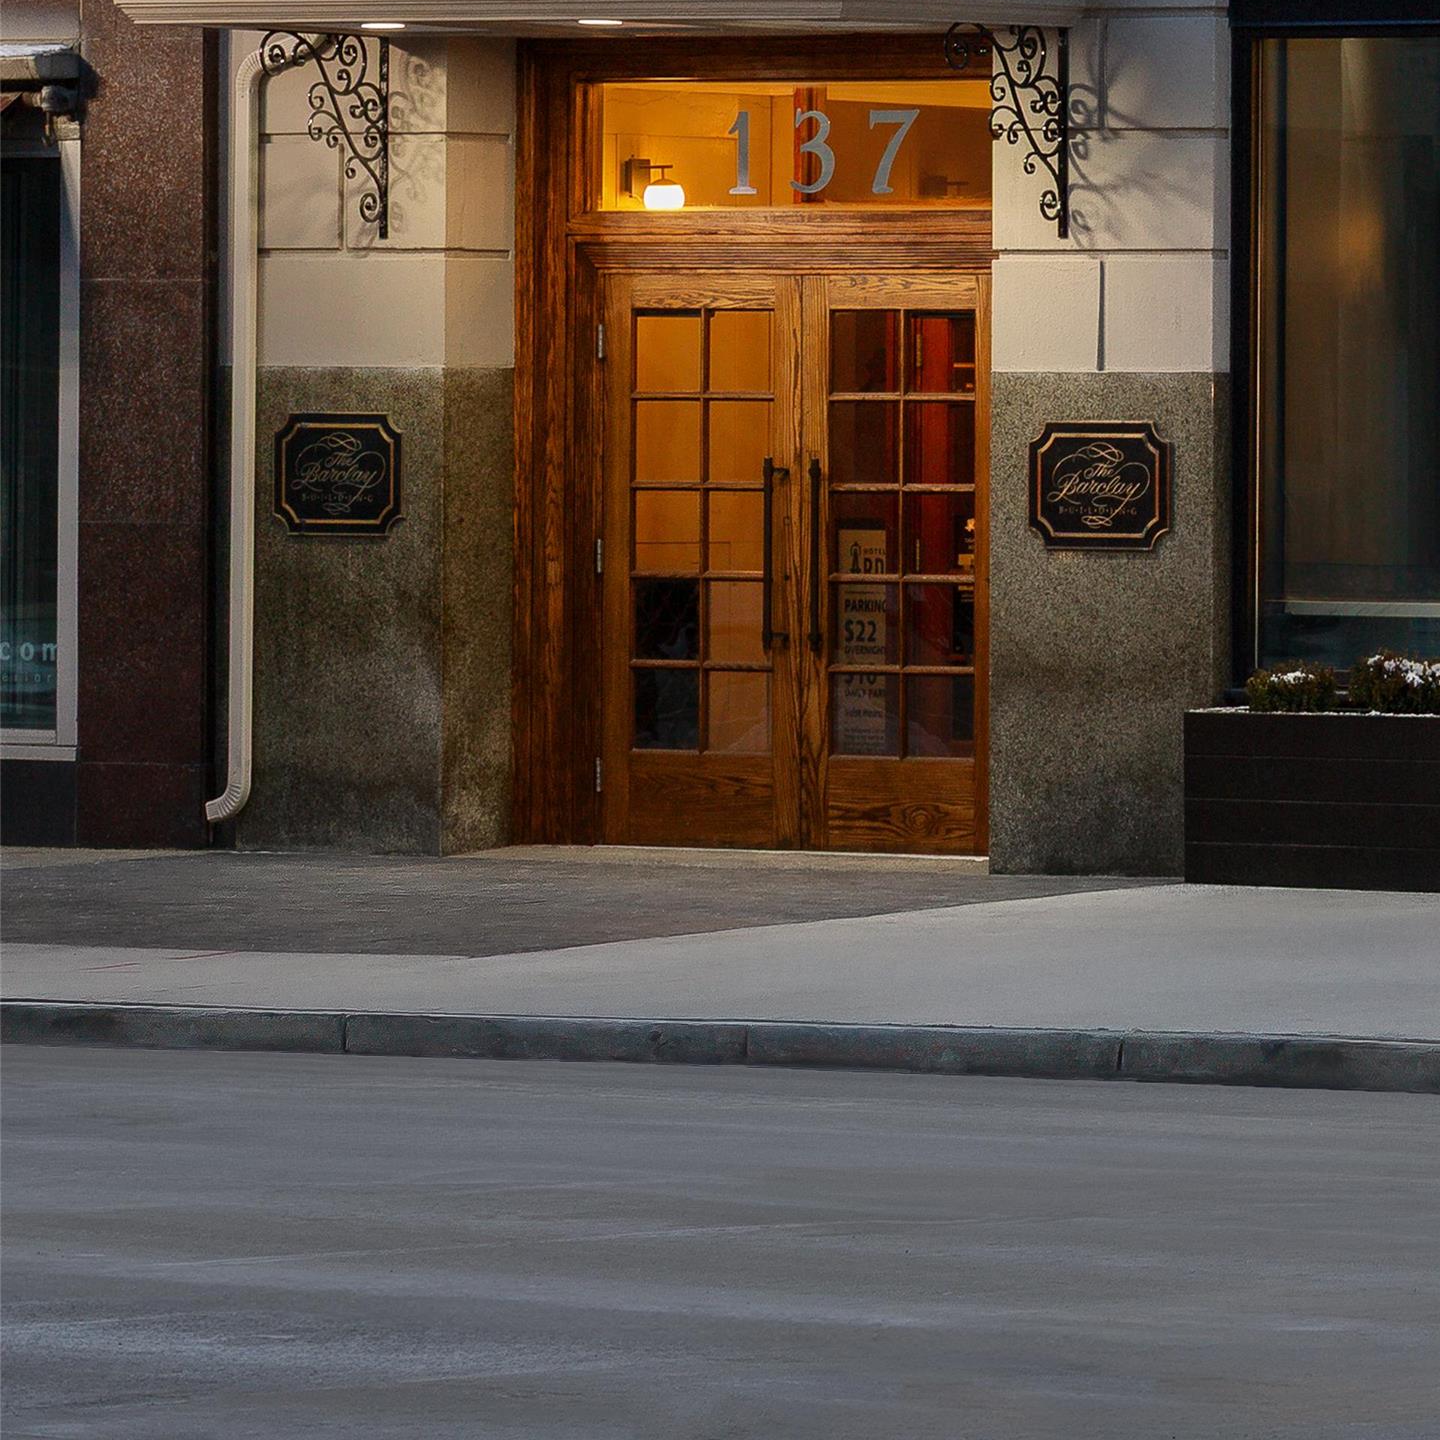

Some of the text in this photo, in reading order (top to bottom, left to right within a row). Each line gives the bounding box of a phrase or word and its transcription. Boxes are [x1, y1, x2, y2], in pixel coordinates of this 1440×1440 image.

[728, 108, 920, 195] 137
[294, 459, 378, 494] Barclay
[324, 451, 354, 469] The
[1083, 462, 1114, 479] The
[1049, 469, 1141, 506] Barclay
